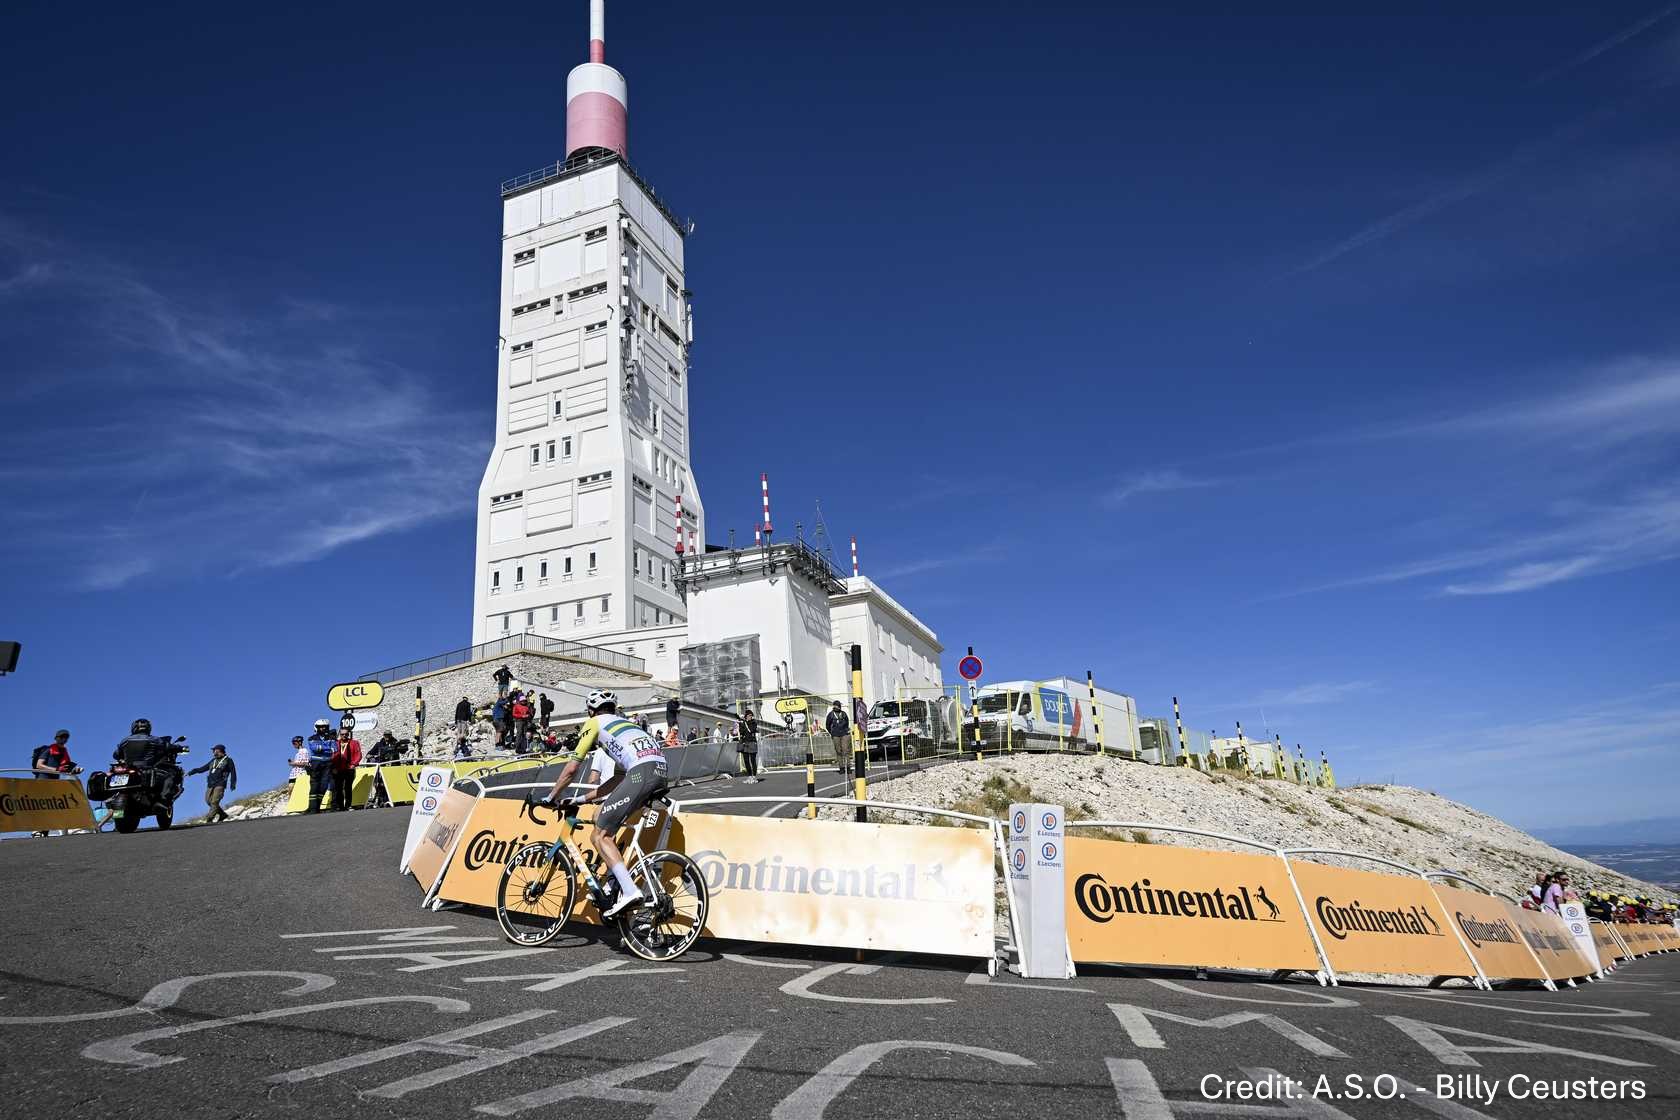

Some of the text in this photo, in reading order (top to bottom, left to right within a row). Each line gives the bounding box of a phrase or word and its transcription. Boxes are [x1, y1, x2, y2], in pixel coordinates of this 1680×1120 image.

[345, 687, 368, 697] LCL
[341, 718, 354, 728] 100
[0, 793, 70, 816] Continental
[601, 796, 631, 814] Jayco
[648, 813, 658, 827] 123
[684, 849, 917, 901] Continental
[1074, 872, 1259, 924] Continental
[1316, 896, 1429, 940] Continental
[1455, 911, 1514, 948] Continental
